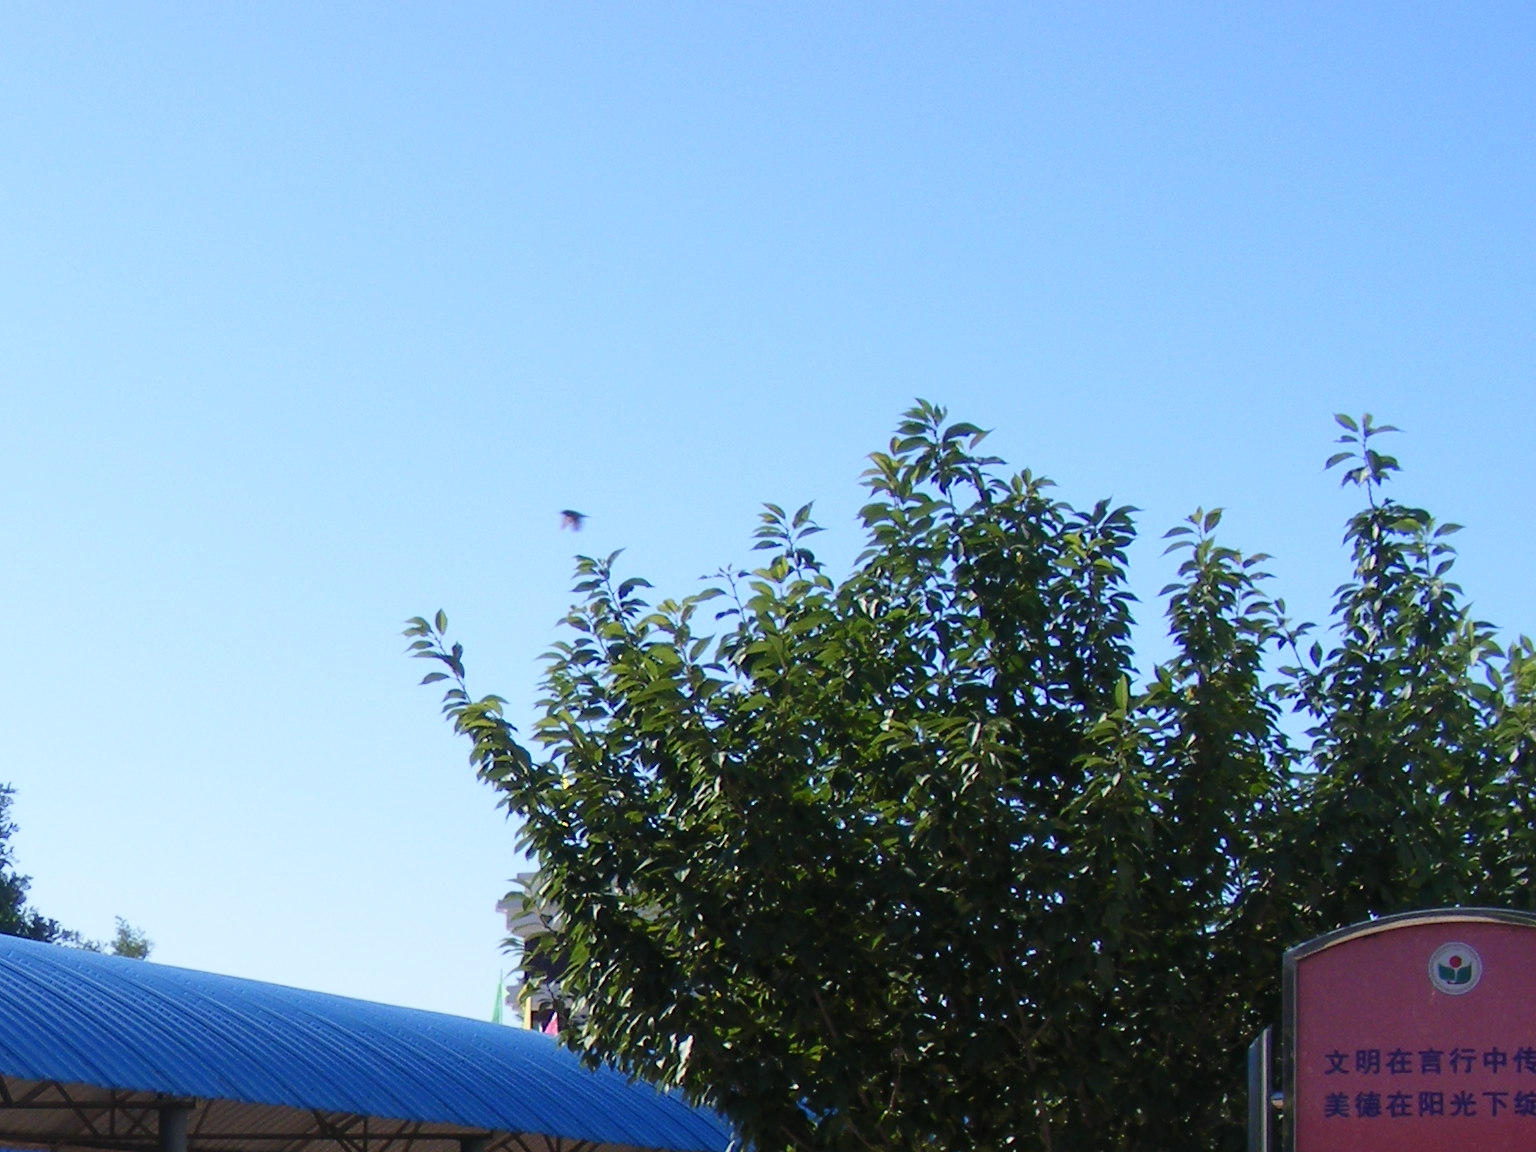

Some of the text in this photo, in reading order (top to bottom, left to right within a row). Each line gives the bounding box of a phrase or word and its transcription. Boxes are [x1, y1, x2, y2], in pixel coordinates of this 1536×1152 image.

[1324, 1047, 1536, 1075] 文明在言行中传
[1324, 1091, 1536, 1118] 美德在阳光下绽
